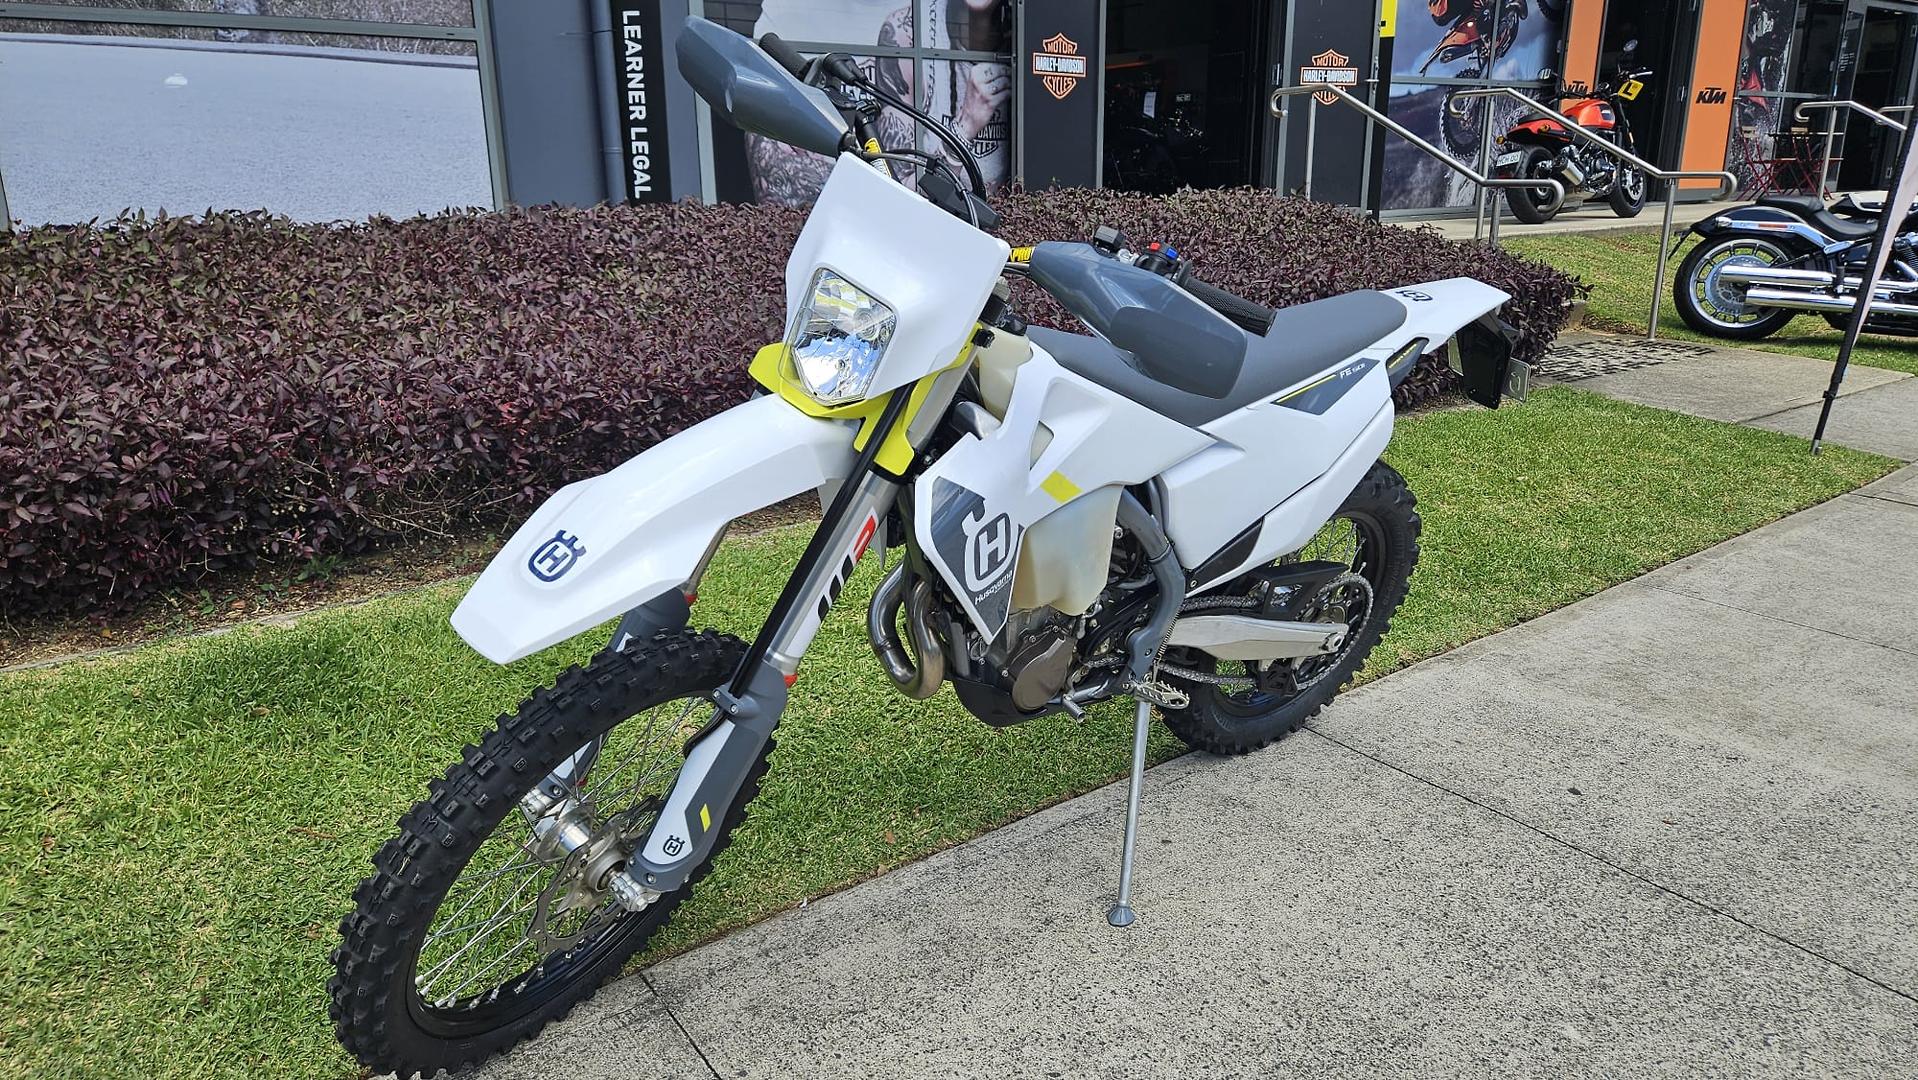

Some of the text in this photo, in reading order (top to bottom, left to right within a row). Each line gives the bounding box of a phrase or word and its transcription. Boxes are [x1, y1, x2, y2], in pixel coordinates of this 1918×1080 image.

[1047, 37, 1074, 54] MOTOR
[1316, 53, 1345, 67] MOTOR
[1047, 76, 1073, 96] CYCLES
[622, 10, 652, 199] LEARNER LEGAL
[1696, 87, 1727, 104] KTM
[974, 570, 1013, 606] Husqvarna
